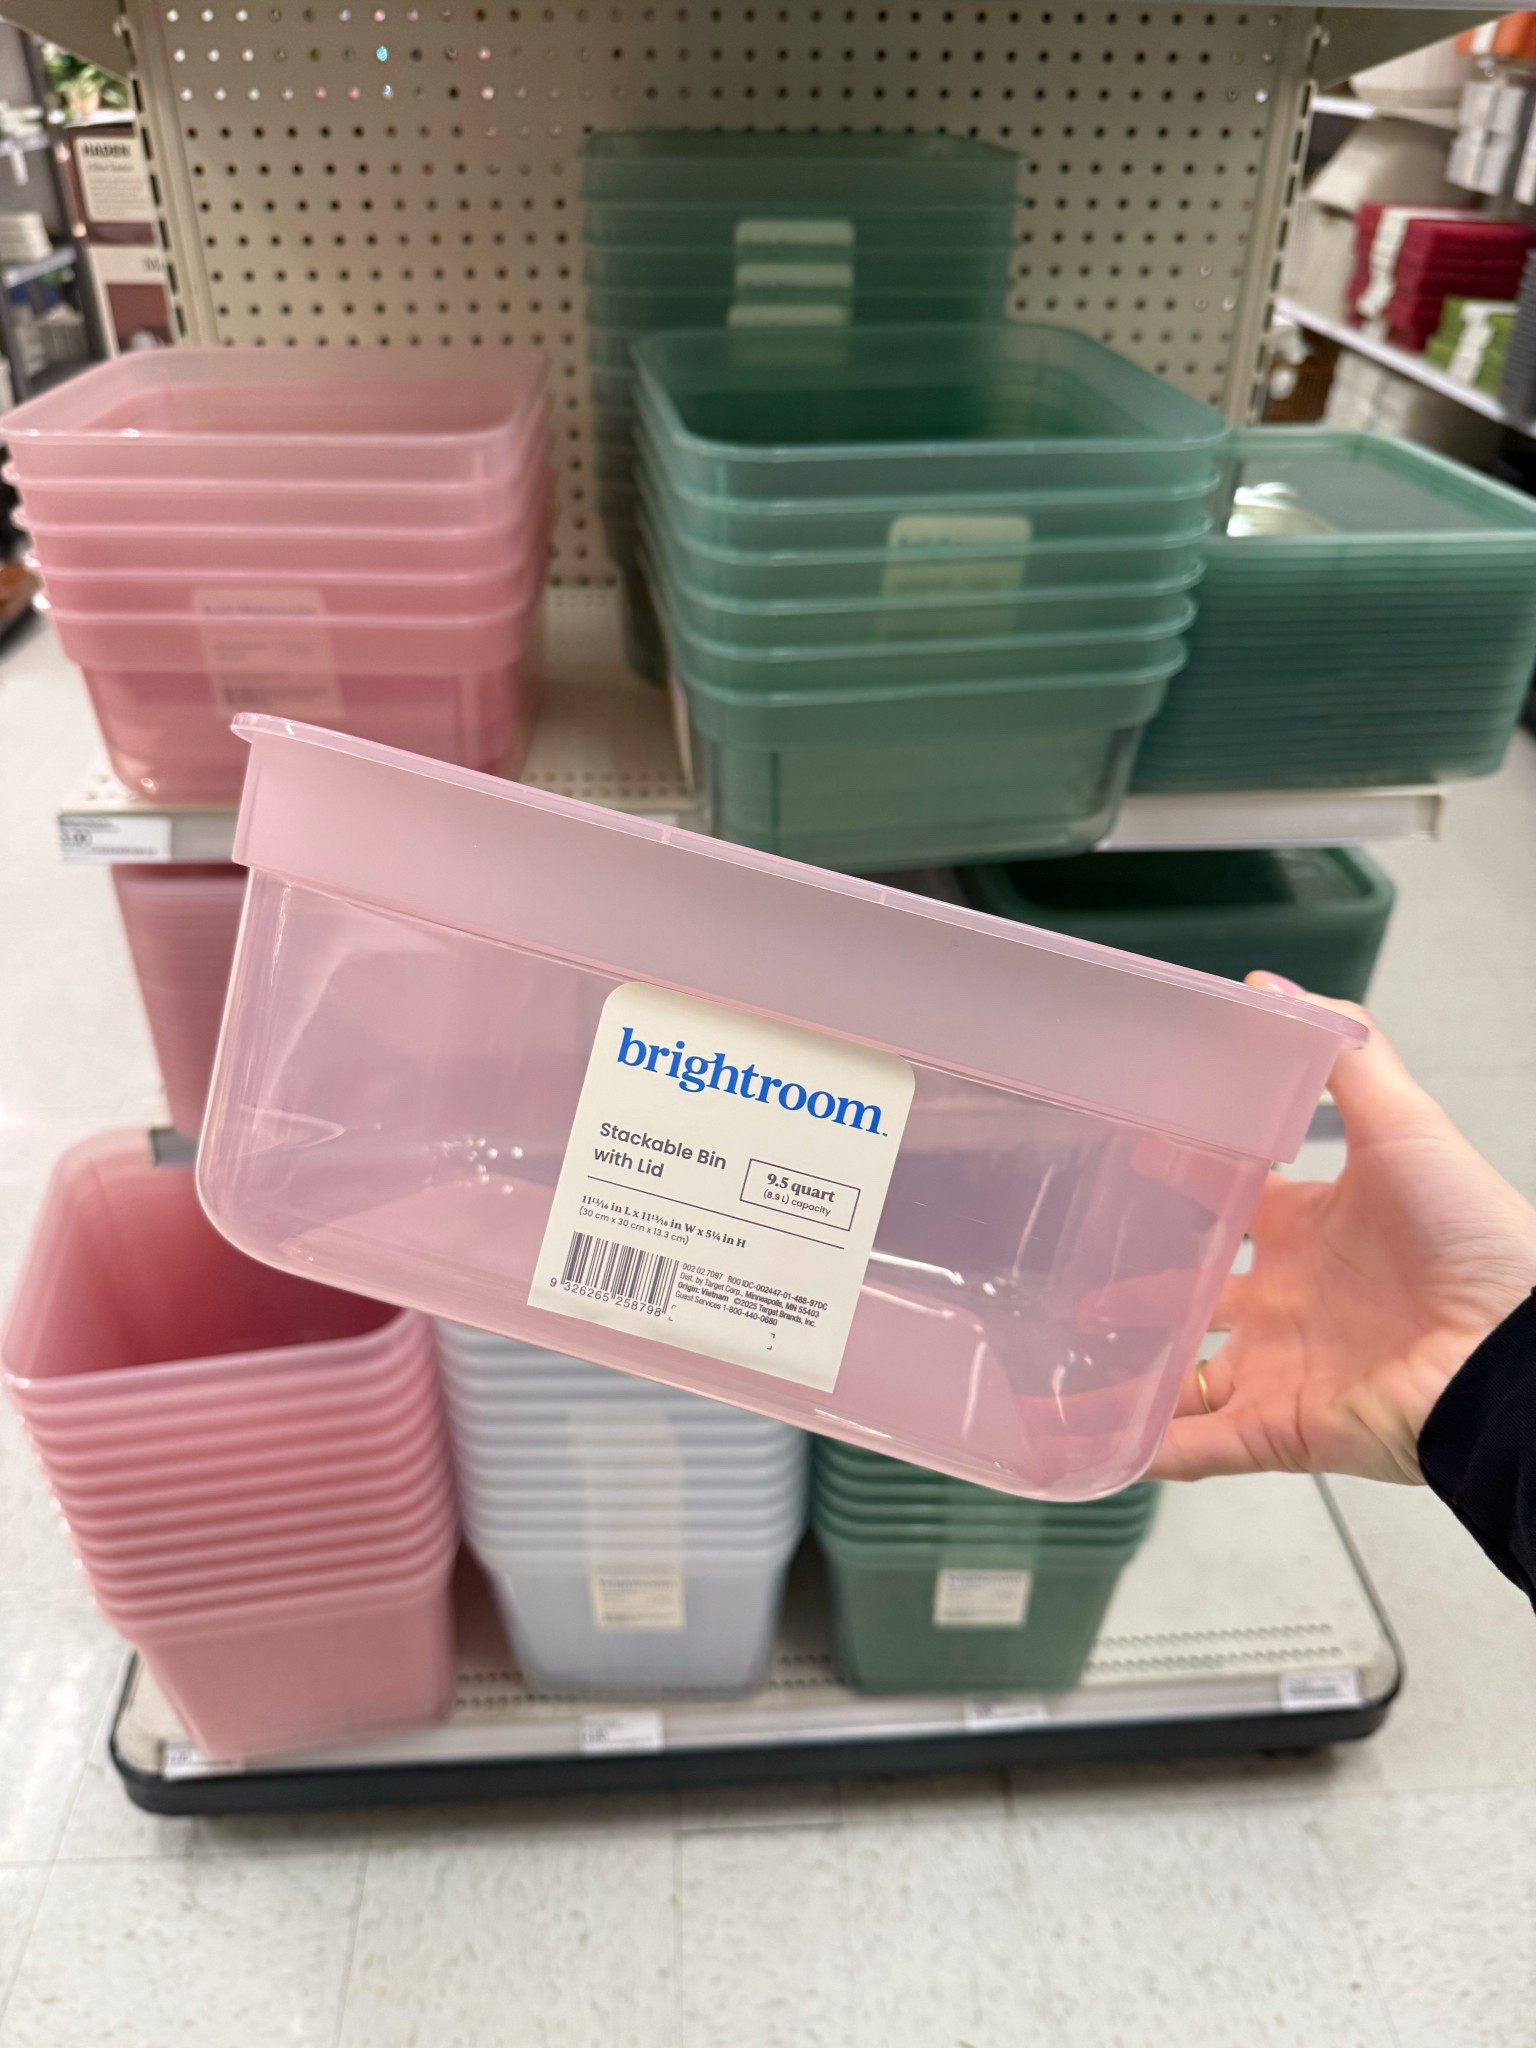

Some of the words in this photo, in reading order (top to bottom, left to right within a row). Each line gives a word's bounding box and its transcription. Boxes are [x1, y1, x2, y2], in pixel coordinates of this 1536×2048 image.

[617, 1027, 886, 1136] brightroom
[594, 1148, 633, 1170] with
[637, 1158, 665, 1178] Lid
[600, 1122, 693, 1160] Stackable
[697, 1149, 727, 1170] Bin
[763, 1189, 781, 1201] (8.9
[782, 1194, 790, 1205] L)
[791, 1199, 832, 1217] capacity
[767, 1173, 789, 1189] 9.5
[791, 1182, 836, 1203] quart
[579, 1205, 594, 1217] (30
[595, 1212, 610, 1222] cm
[617, 1218, 629, 1227] 30
[630, 1223, 645, 1232] cm
[653, 1228, 670, 1239] 13.3
[670, 1234, 689, 1246] cm)
[610, 1202, 622, 1213] in
[624, 1206, 631, 1216] L
[632, 1210, 640, 1218] x
[670, 1218, 682, 1230] in
[685, 1223, 697, 1233] W
[697, 1228, 704, 1236] x
[722, 1233, 734, 1245] in
[736, 1238, 747, 1248] H
[682, 1262, 696, 1272] 002
[696, 1266, 706, 1276] 02
[706, 1269, 724, 1280] 7097
[549, 1277, 558, 1287] 9
[563, 1281, 610, 1302] 326265
[615, 1296, 662, 1317] 258798
[675, 1290, 694, 1301] Guest
[694, 1295, 721, 1310] Services
[722, 1304, 778, 1326] 1-800-440-0680
[677, 1281, 701, 1294] Origin:
[701, 1287, 729, 1302] Vietnam
[733, 1297, 757, 1310] ©2025
[759, 1303, 779, 1317] Target
[779, 1310, 803, 1325] Brands,
[804, 1317, 816, 1327] Inc.
[680, 1271, 694, 1282] Dist.
[695, 1276, 704, 1286] by
[705, 1279, 725, 1291] Target
[725, 1284, 744, 1297] Corp.,
[745, 1290, 784, 1309] Minneapolis,
[785, 1302, 798, 1312] MN
[798, 1305, 820, 1318] 55403
